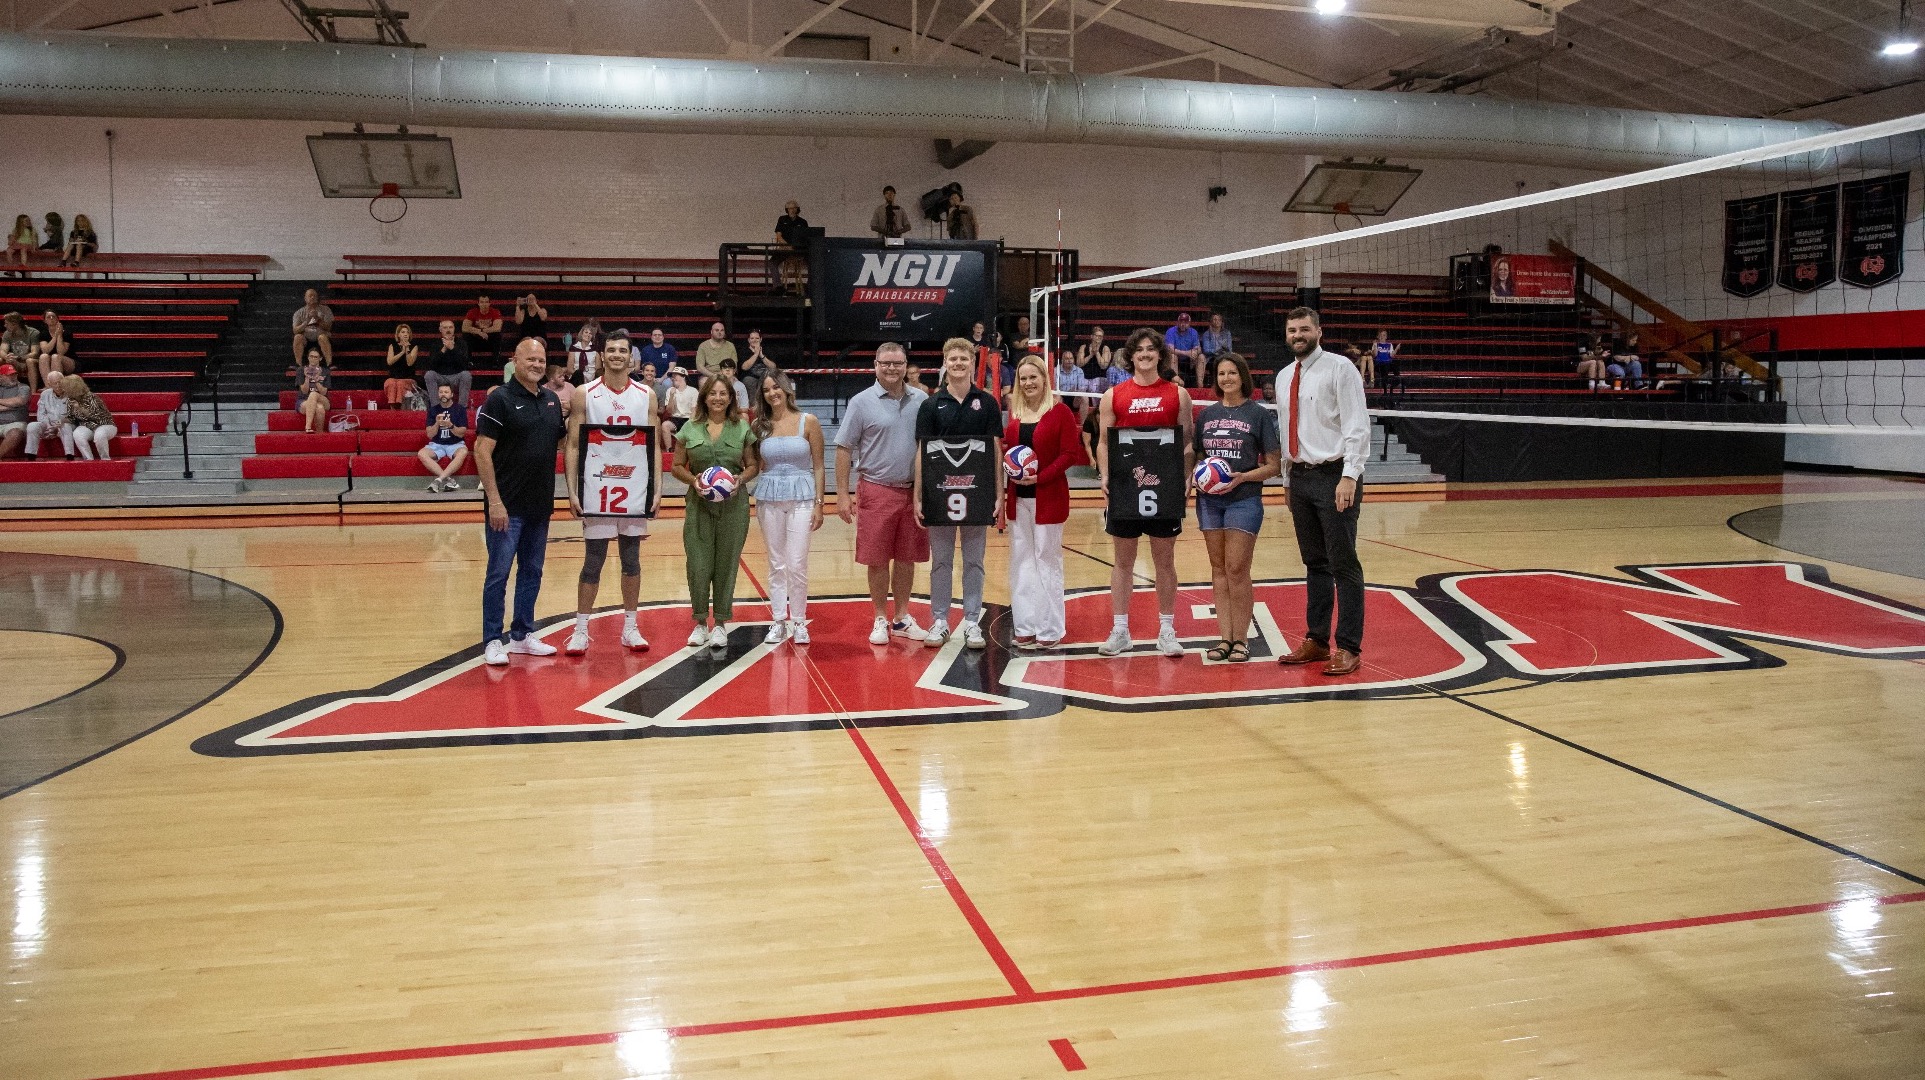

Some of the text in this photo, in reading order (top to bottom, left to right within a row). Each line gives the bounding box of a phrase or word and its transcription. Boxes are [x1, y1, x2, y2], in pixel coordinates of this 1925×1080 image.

[853, 253, 962, 287] NGU
[859, 290, 938, 300] TRAILBLAZERS
[599, 485, 629, 513] 12
[947, 493, 967, 521] 9
[1138, 489, 1158, 517] 6
